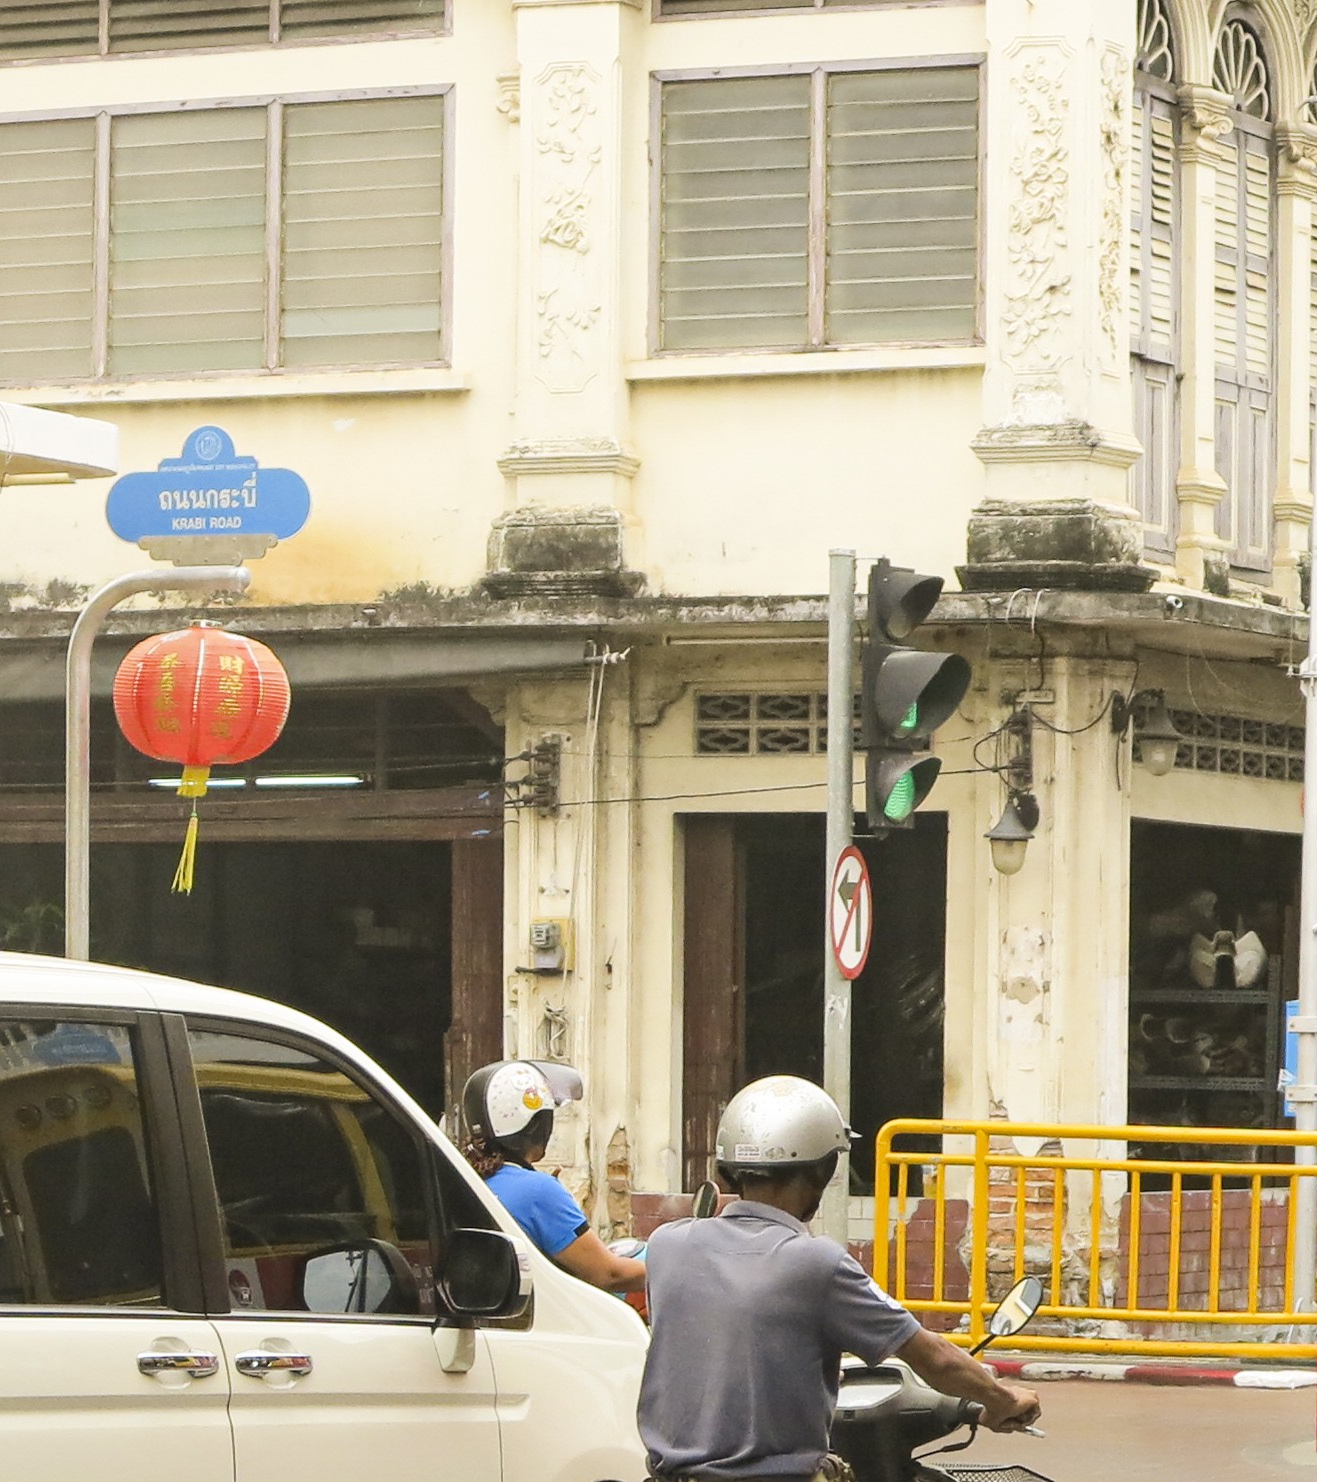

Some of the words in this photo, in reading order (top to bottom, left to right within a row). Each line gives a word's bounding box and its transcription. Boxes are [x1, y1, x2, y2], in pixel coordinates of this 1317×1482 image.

[159, 471, 257, 510] ถนนกระบี่
[171, 516, 206, 530] KRABI
[210, 516, 242, 529] ROAD
